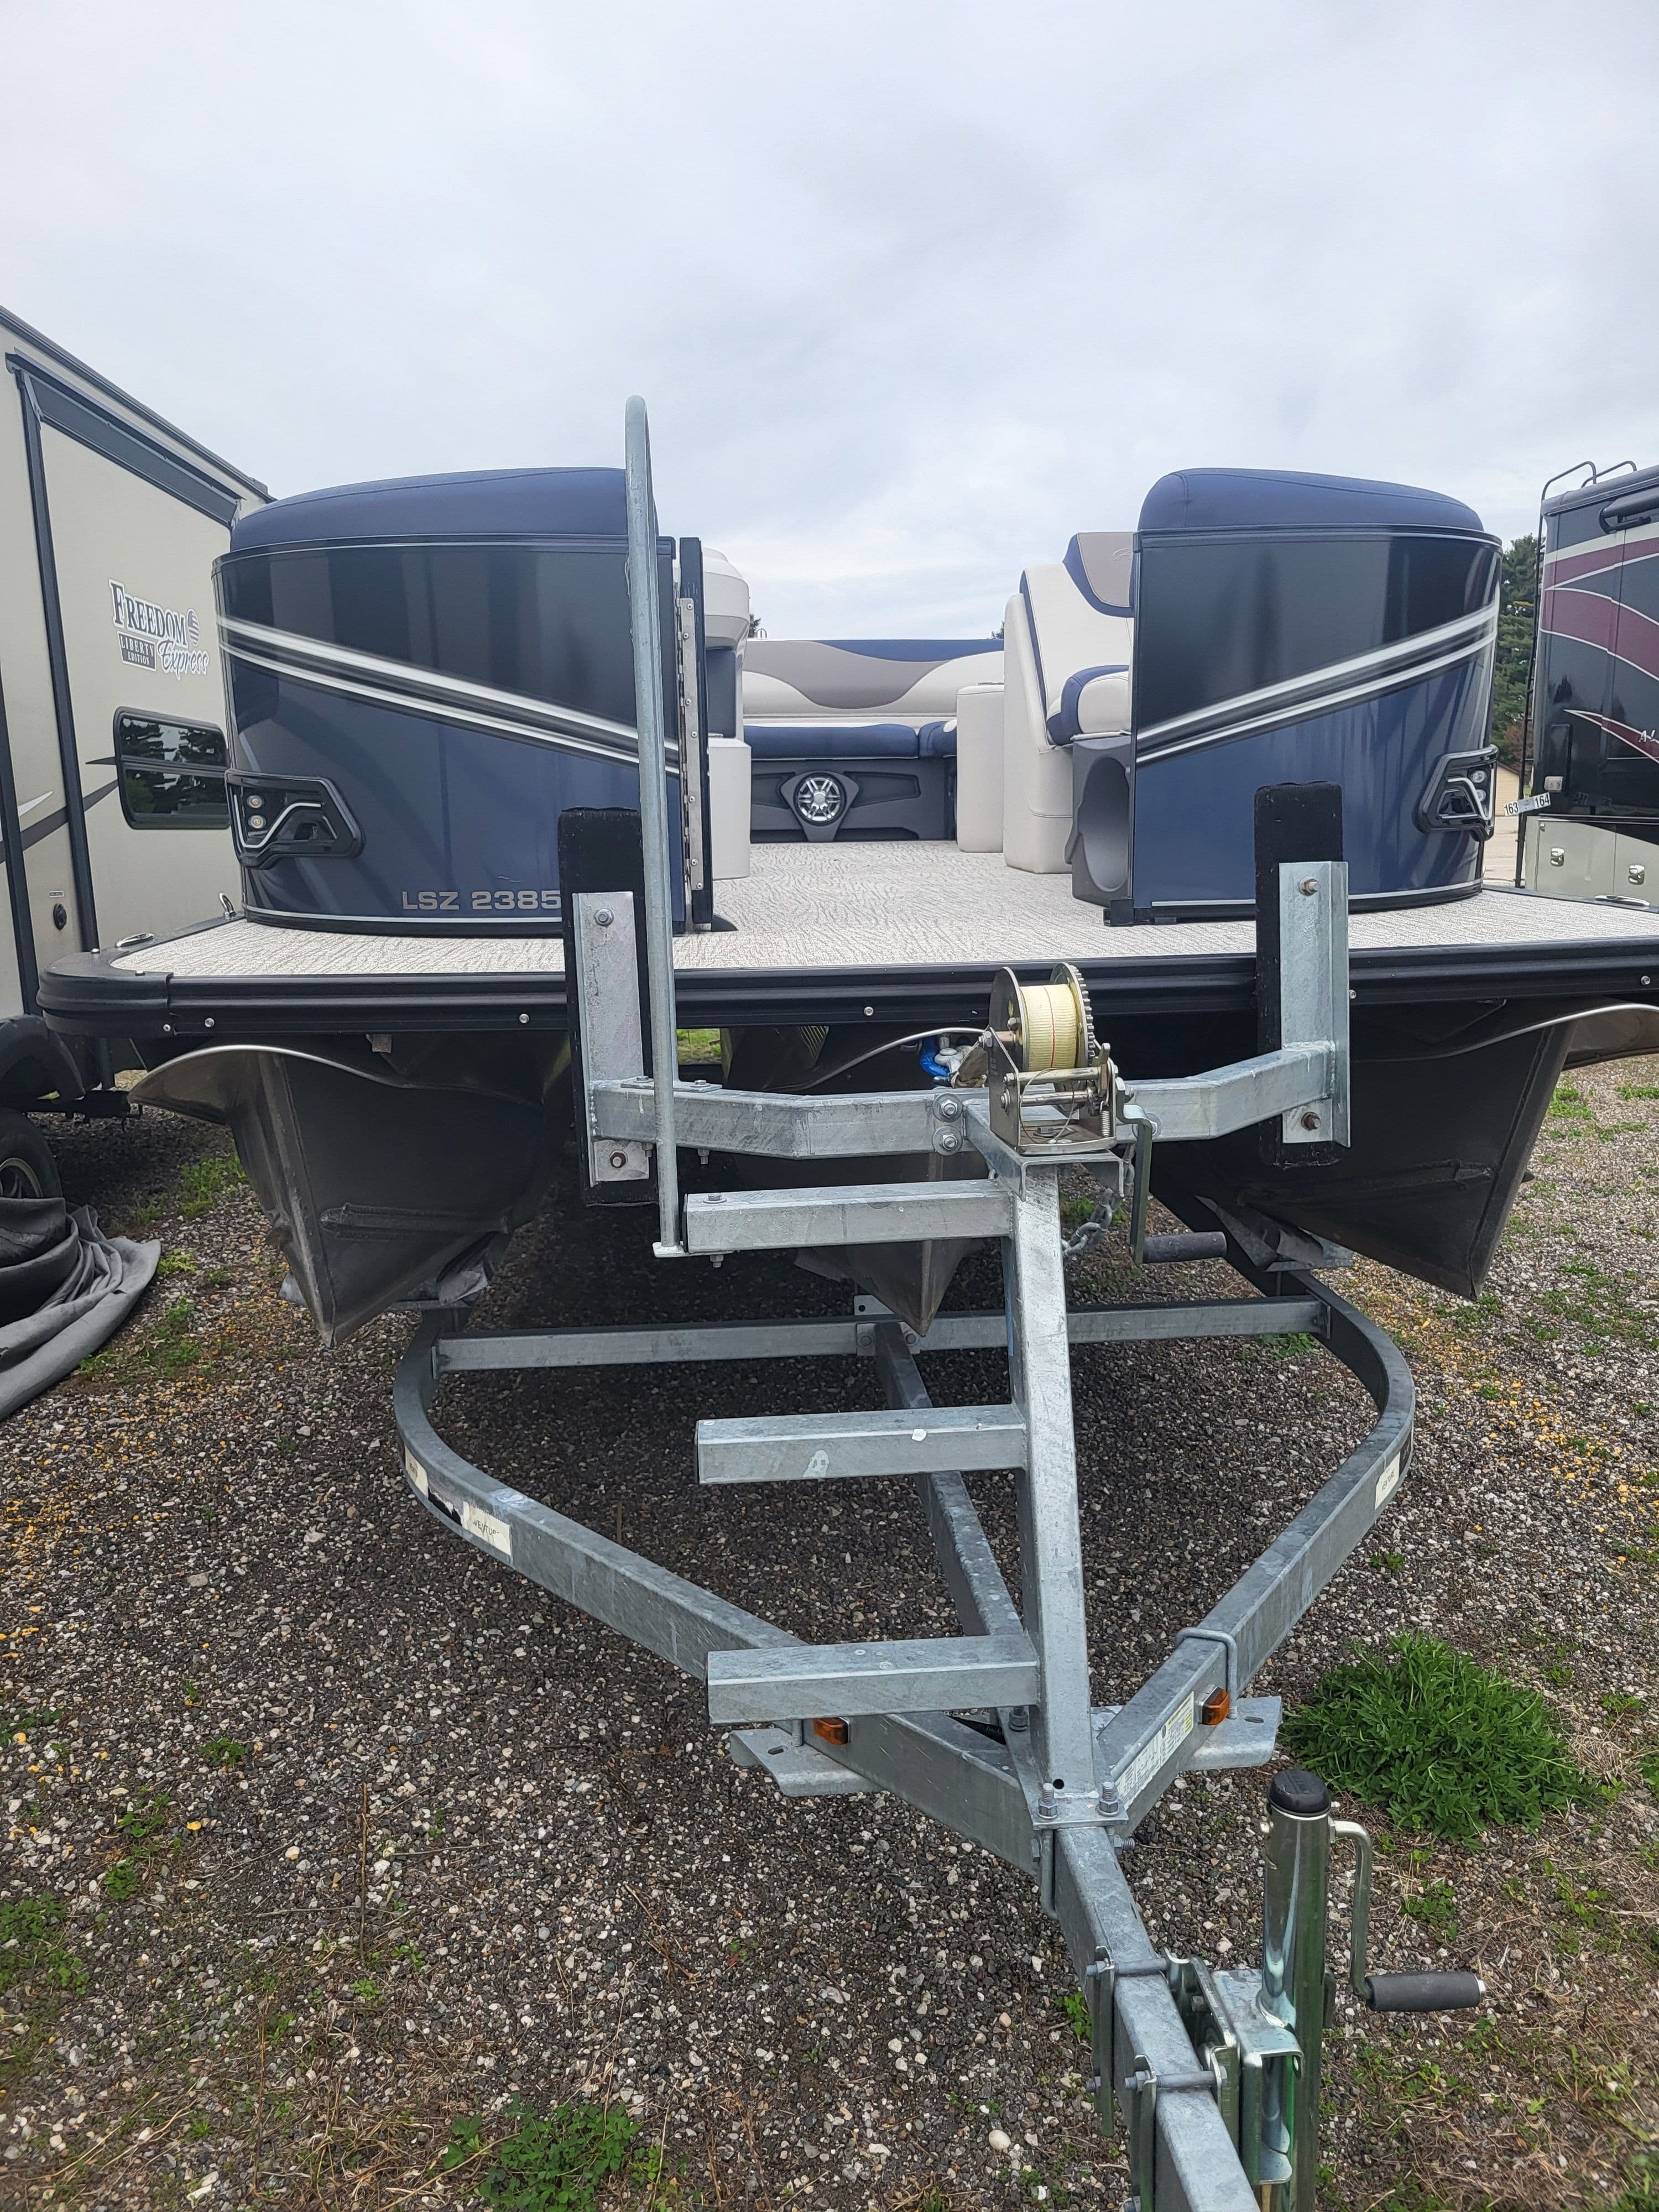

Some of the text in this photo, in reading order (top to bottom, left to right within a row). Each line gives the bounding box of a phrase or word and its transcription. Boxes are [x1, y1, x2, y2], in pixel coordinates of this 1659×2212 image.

[110, 582, 187, 646] FREEDOM
[120, 635, 155, 658] LIBERTY
[127, 650, 150, 666] EDITION
[158, 640, 208, 680] Express
[1504, 794, 1550, 815] 163 164
[402, 890, 561, 910] LSZ 2385
